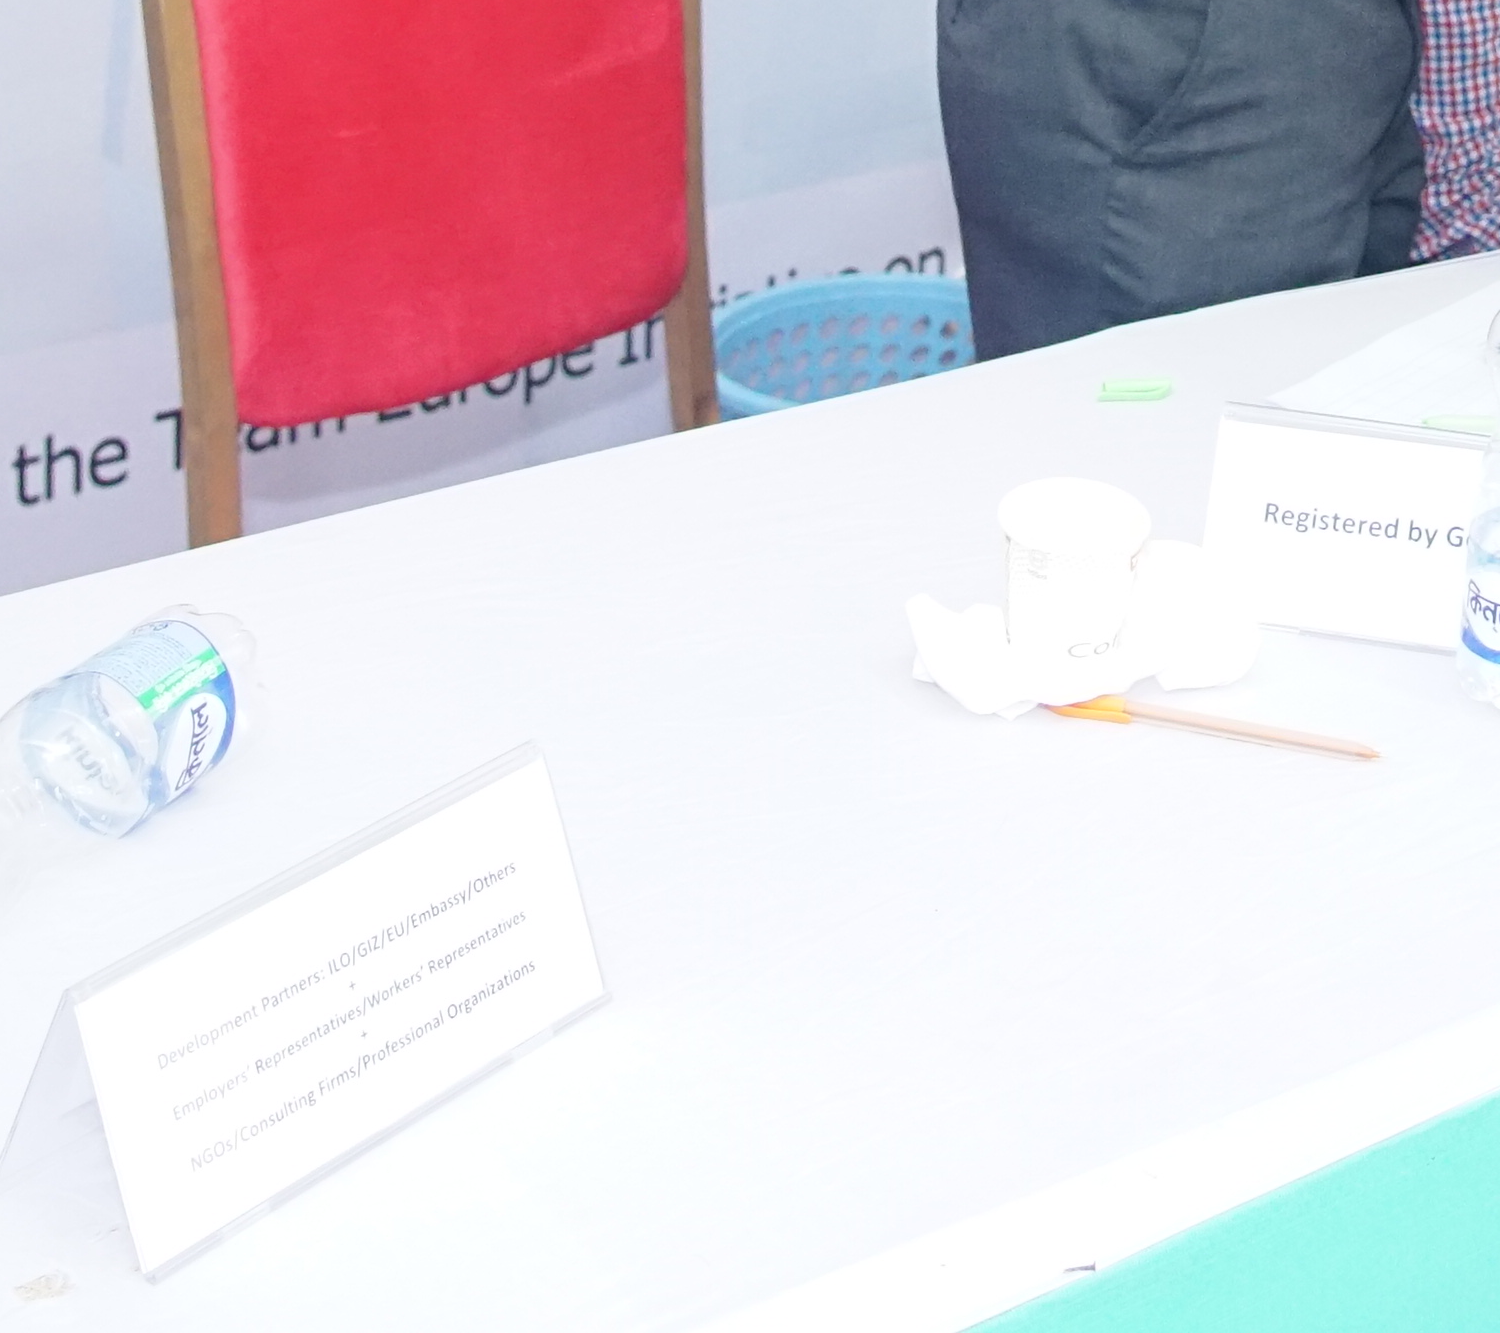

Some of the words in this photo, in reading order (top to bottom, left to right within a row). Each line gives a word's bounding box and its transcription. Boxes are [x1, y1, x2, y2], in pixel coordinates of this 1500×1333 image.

[11, 433, 131, 508] the
[1264, 502, 1400, 540] Registered
[1407, 519, 1439, 549] by
[157, 1005, 259, 1071] Development
[260, 965, 327, 1017] Partners:
[326, 859, 518, 977] ILO/GIZ/EU/Embassy/Others
[426, 908, 529, 976] Representatives
[189, 1085, 318, 1173] NGOs/Consulting
[316, 1013, 447, 1097] Firms/Professional
[446, 957, 537, 1023] Organizations
